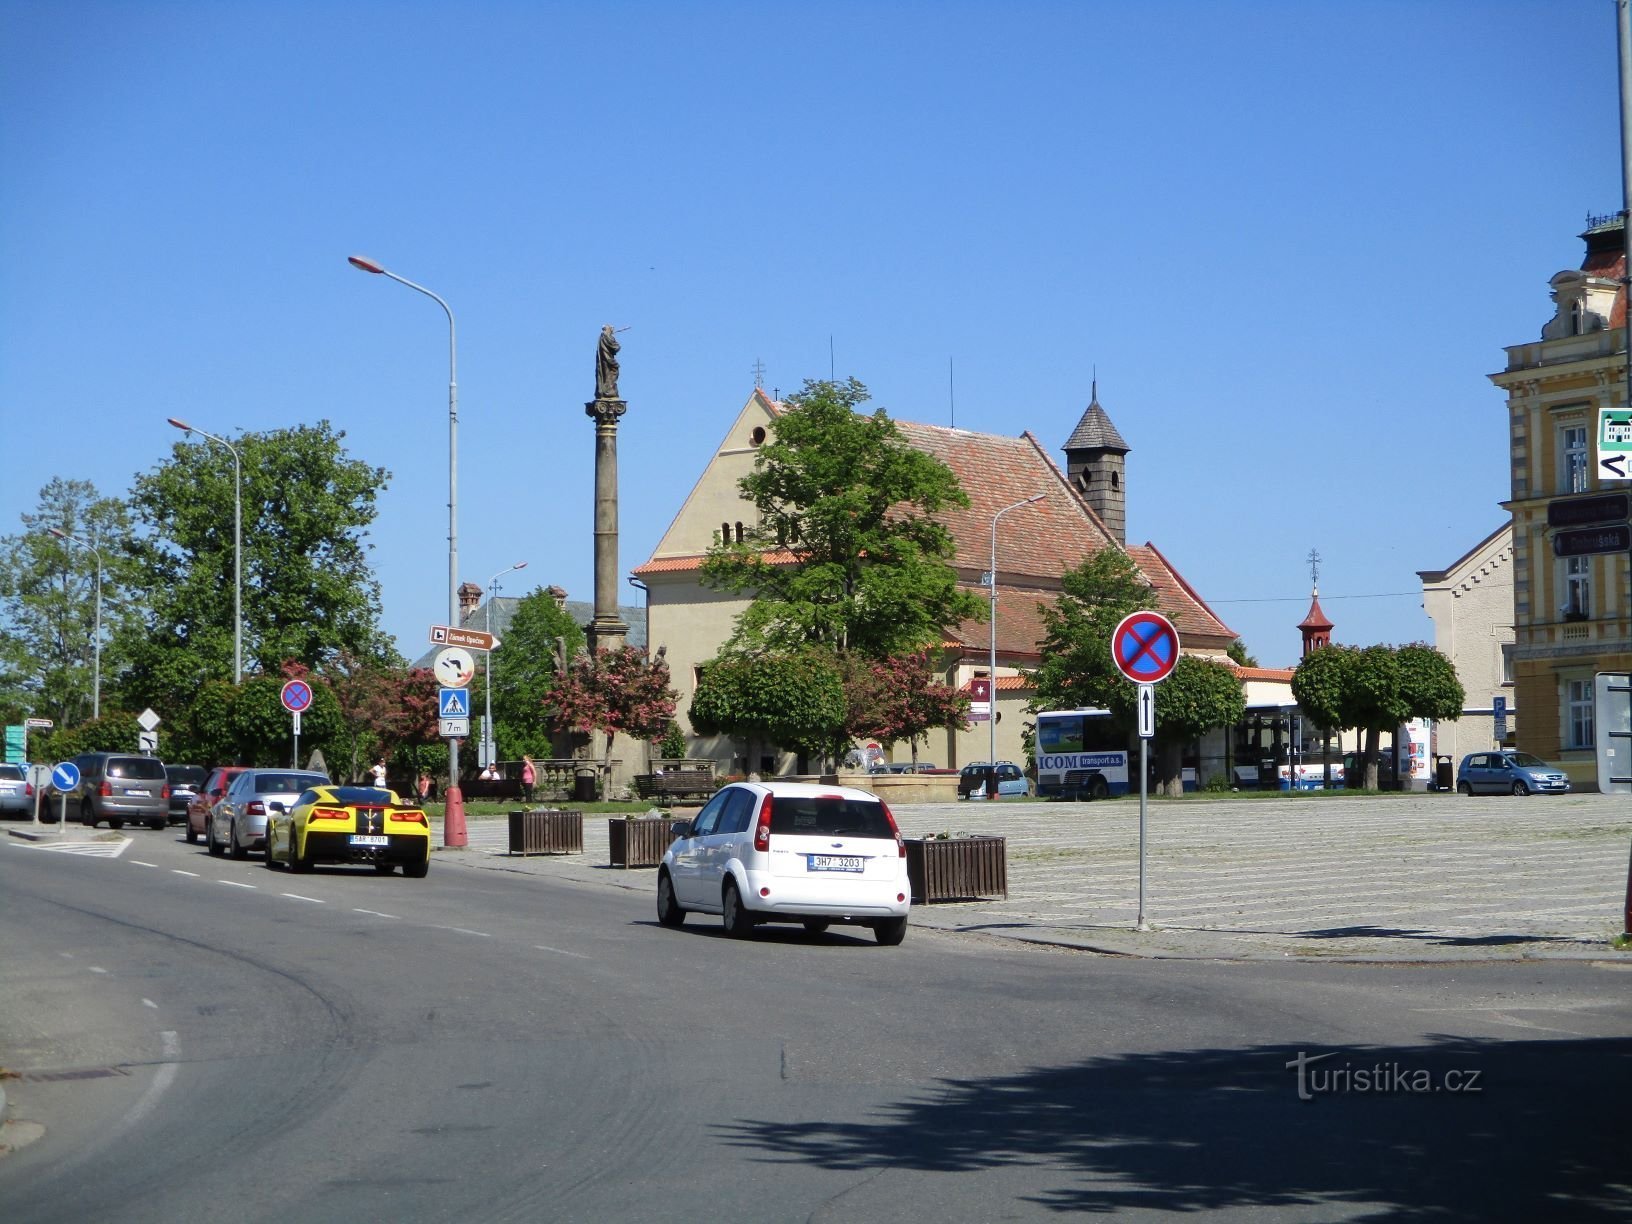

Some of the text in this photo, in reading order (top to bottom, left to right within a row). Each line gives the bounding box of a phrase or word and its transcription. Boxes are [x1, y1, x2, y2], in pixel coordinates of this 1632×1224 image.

[446, 722, 453, 732] 7
[1038, 755, 1122, 770] ICOM transport a.s.
[816, 857, 860, 868] 3H7 3203
